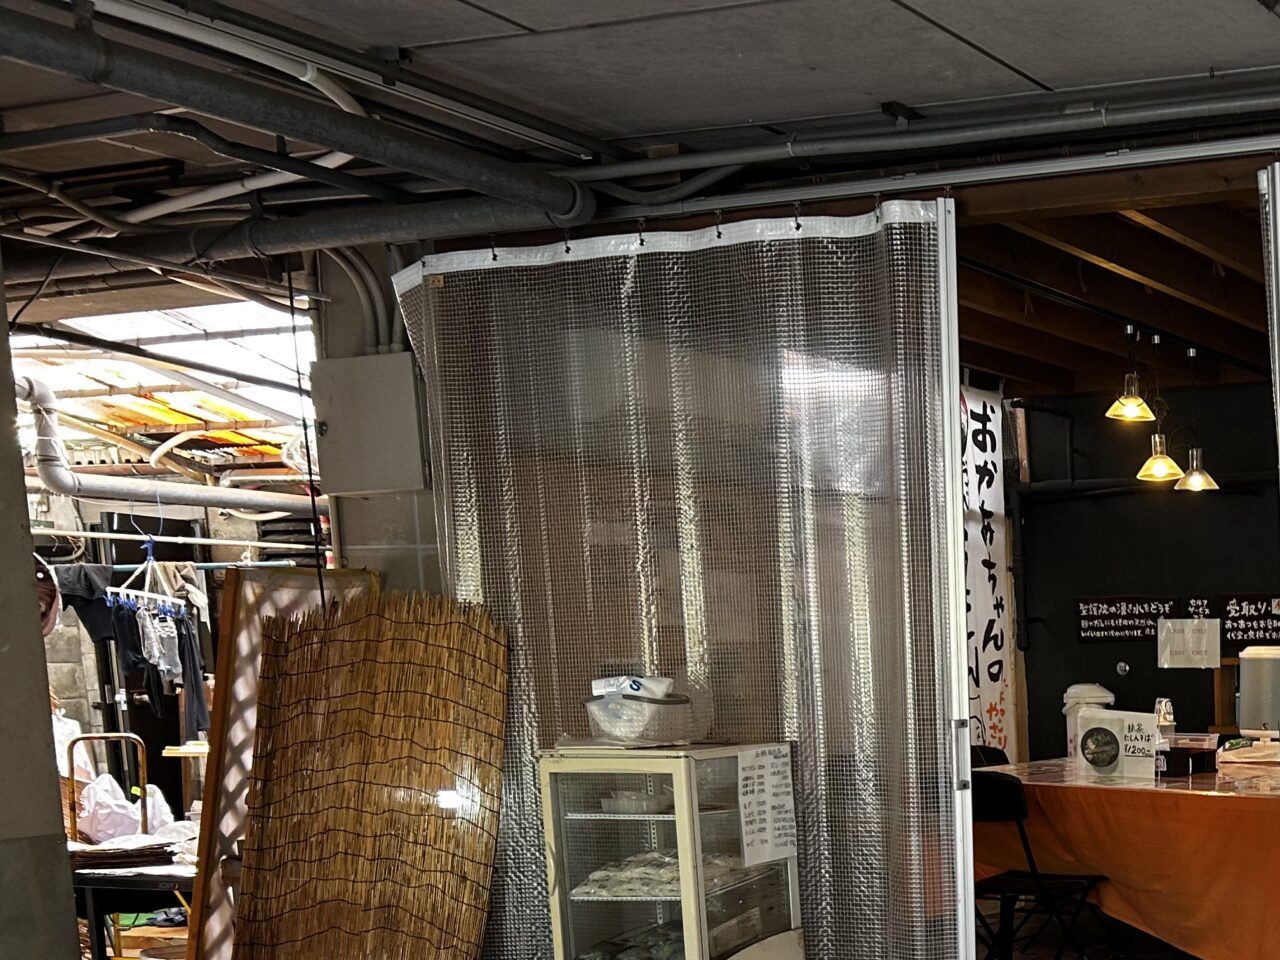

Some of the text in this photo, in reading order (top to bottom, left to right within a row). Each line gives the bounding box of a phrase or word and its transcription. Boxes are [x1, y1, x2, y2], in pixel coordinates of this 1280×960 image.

[969, 400, 1005, 683] おかあちゃんの
